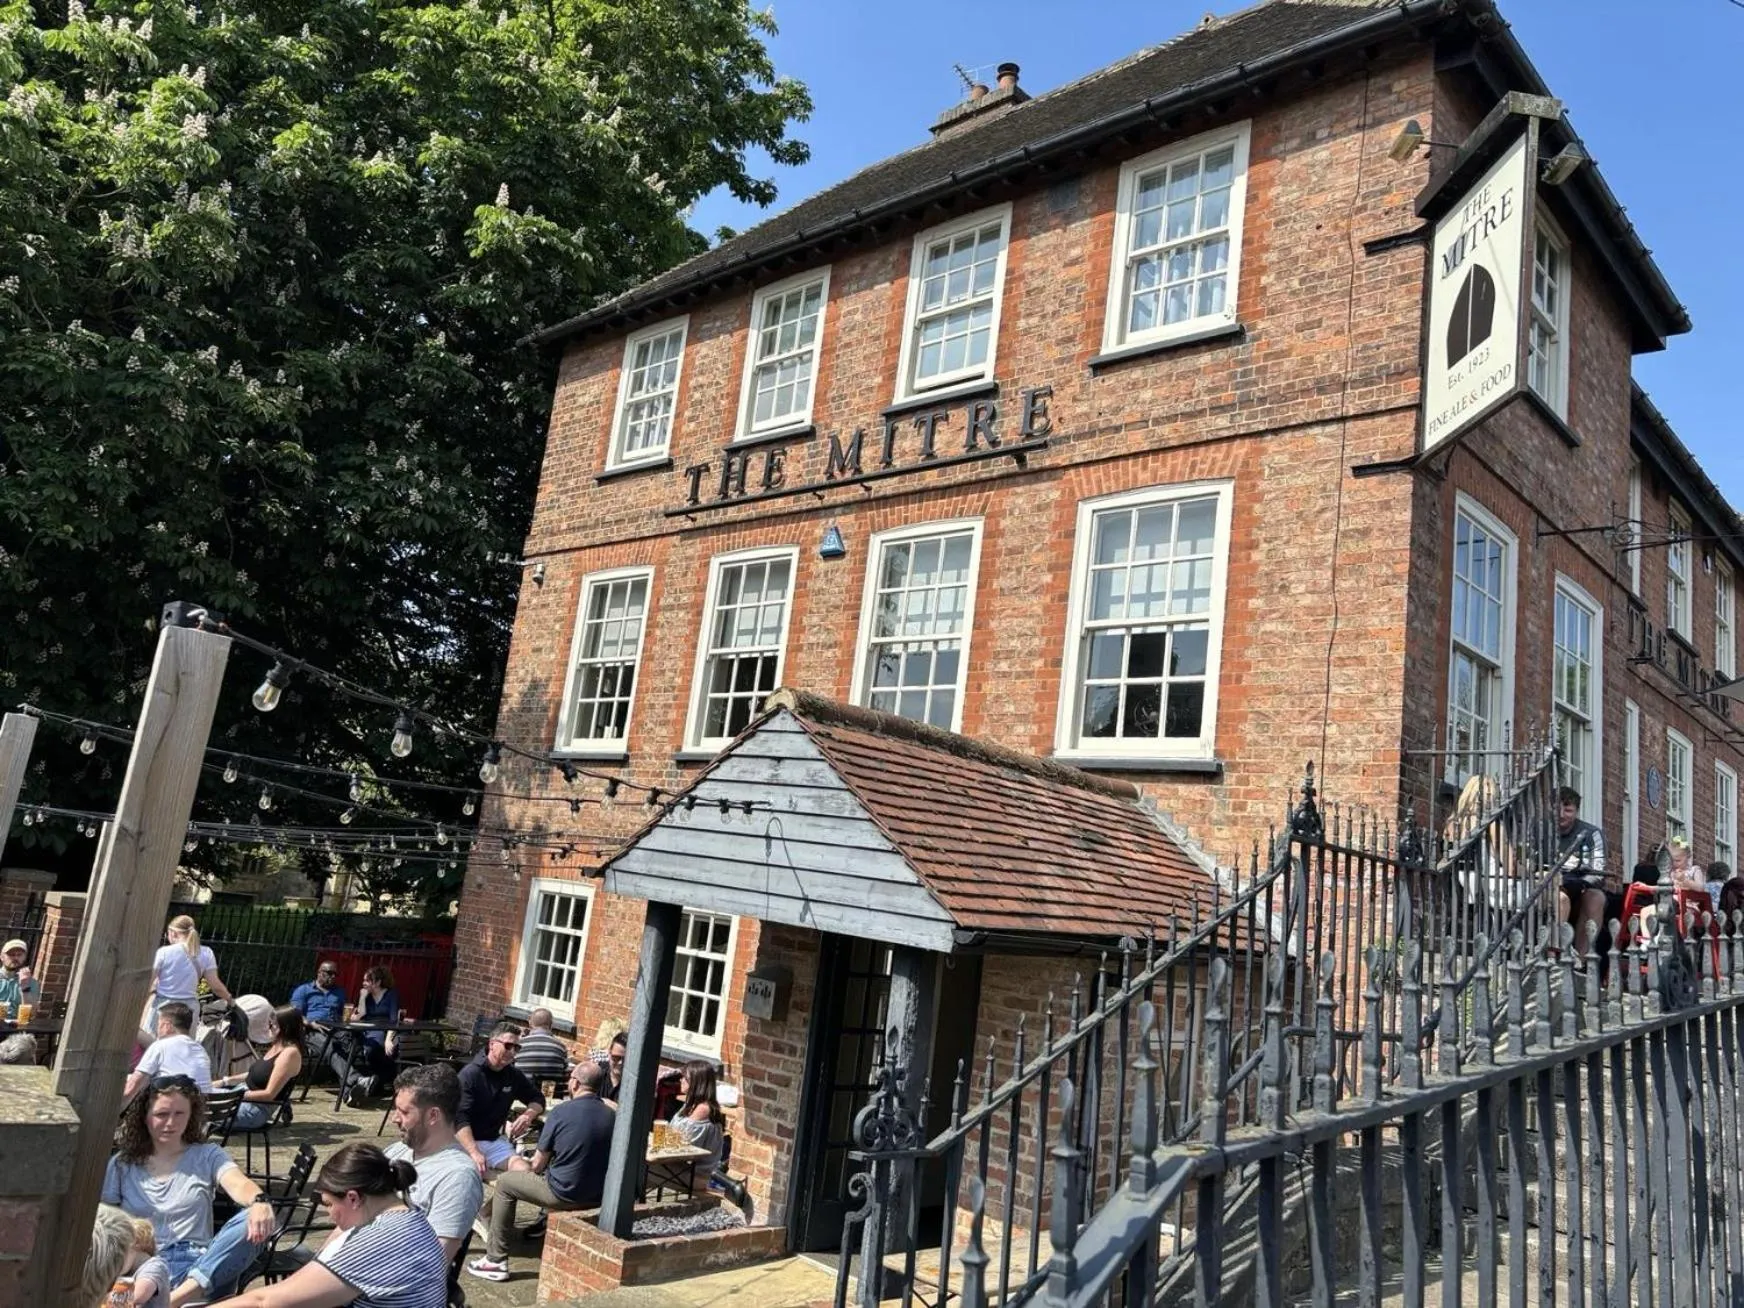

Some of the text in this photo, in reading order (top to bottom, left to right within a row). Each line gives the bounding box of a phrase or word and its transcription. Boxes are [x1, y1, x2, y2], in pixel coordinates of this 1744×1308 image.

[1441, 187, 1513, 280] MITRE
[1463, 184, 1491, 223] THE
[1468, 347, 1490, 373] 1923
[1428, 410, 1449, 436] FINE
[1481, 363, 1512, 397] FOOD
[685, 385, 1054, 505] THE MITRE
